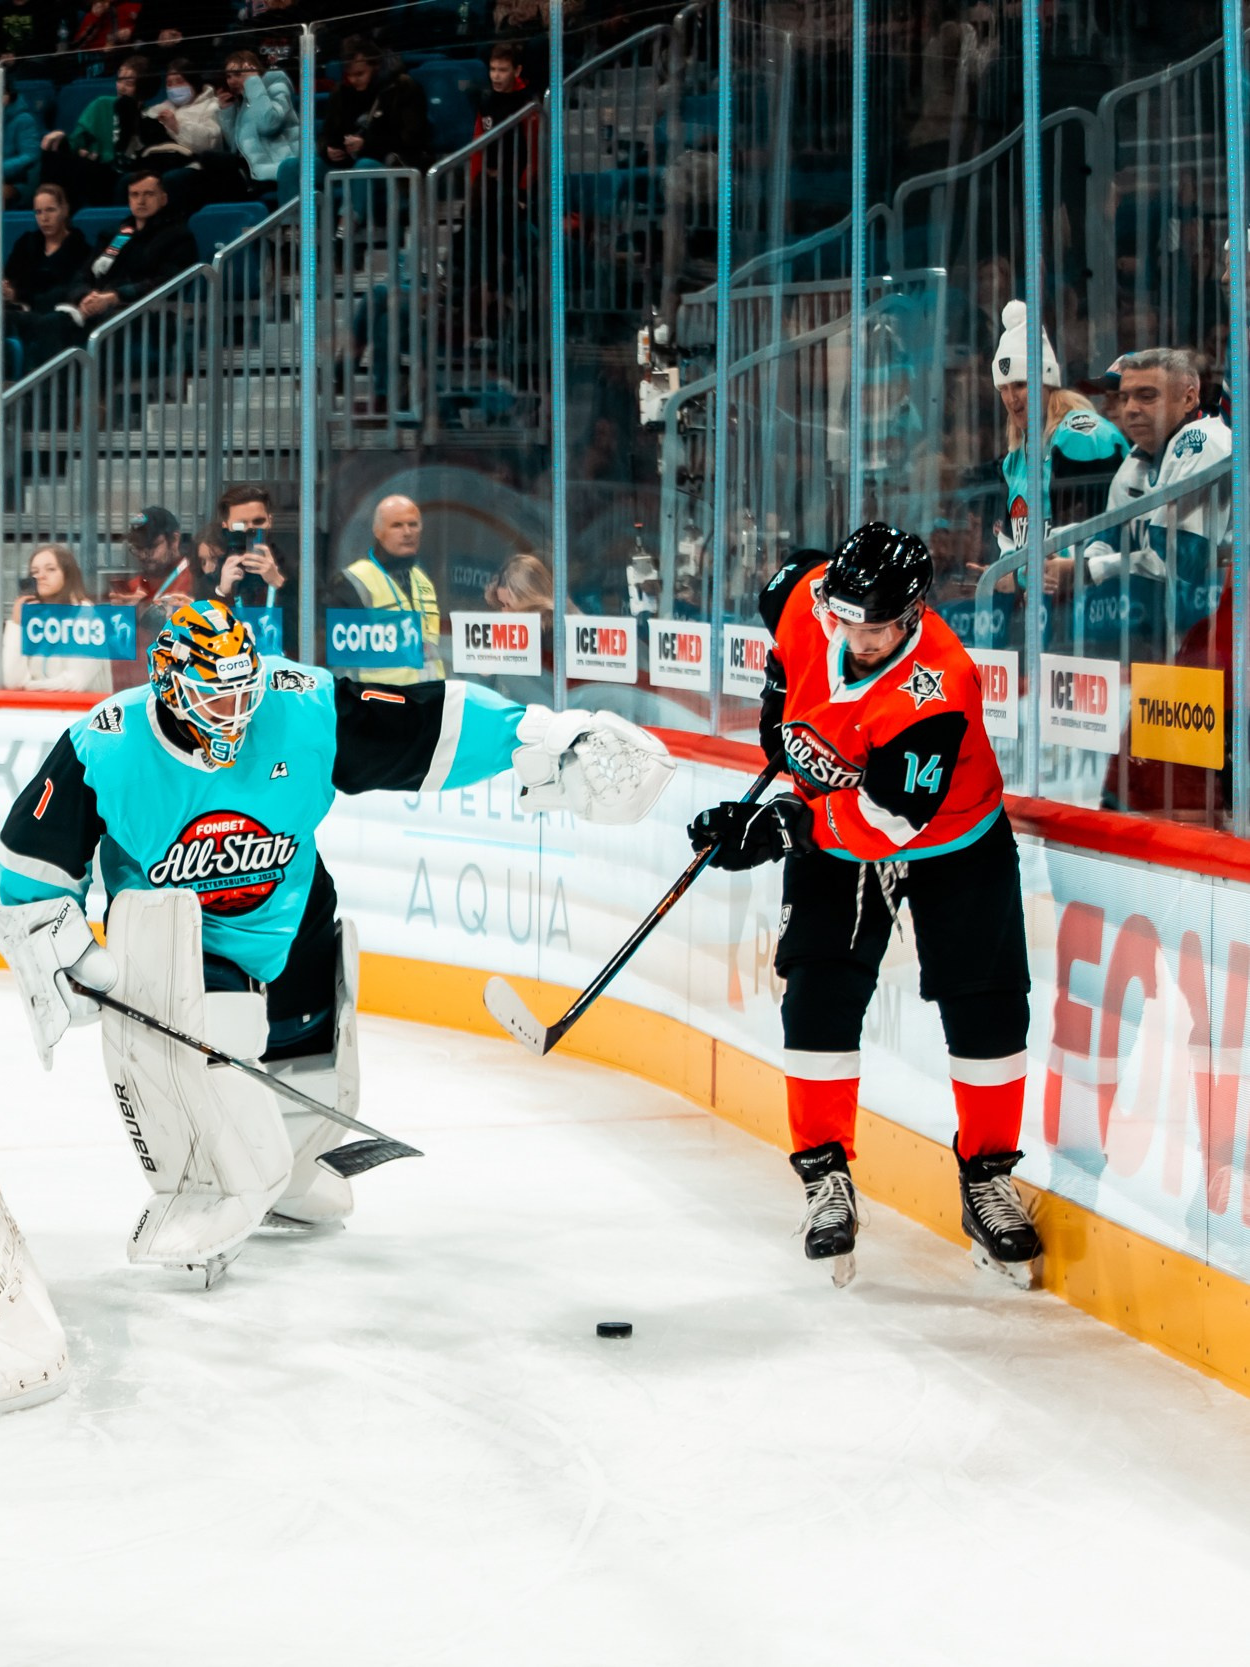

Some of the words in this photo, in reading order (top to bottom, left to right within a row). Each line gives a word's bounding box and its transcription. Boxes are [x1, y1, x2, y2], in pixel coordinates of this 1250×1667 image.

[830, 602, 862, 618] согаз
[26, 616, 106, 646] согаз
[332, 623, 398, 652] согаз
[465, 623, 528, 650] ICEMED
[576, 627, 627, 657] ICEMED
[658, 632, 702, 664] ICEMED
[218, 659, 250, 672] согаз
[730, 637, 766, 671] ICEMED
[973, 664, 1008, 703] MED
[1051, 669, 1108, 716] ICEMED
[1139, 697, 1215, 734] ТИНЬКОФФ
[782, 726, 862, 787] All-Sta
[800, 730, 837, 762] FONBET
[904, 751, 943, 794] 14
[33, 777, 54, 820] 1
[195, 819, 246, 836] FONBET
[150, 832, 297, 884] All-Star
[198, 876, 250, 890] PETERSBURG
[258, 872, 277, 881] 2023
[52, 903, 71, 938] MACH
[405, 856, 571, 952] AQUA
[1042, 900, 1250, 1228] FON
[133, 1209, 150, 1243] MACH
